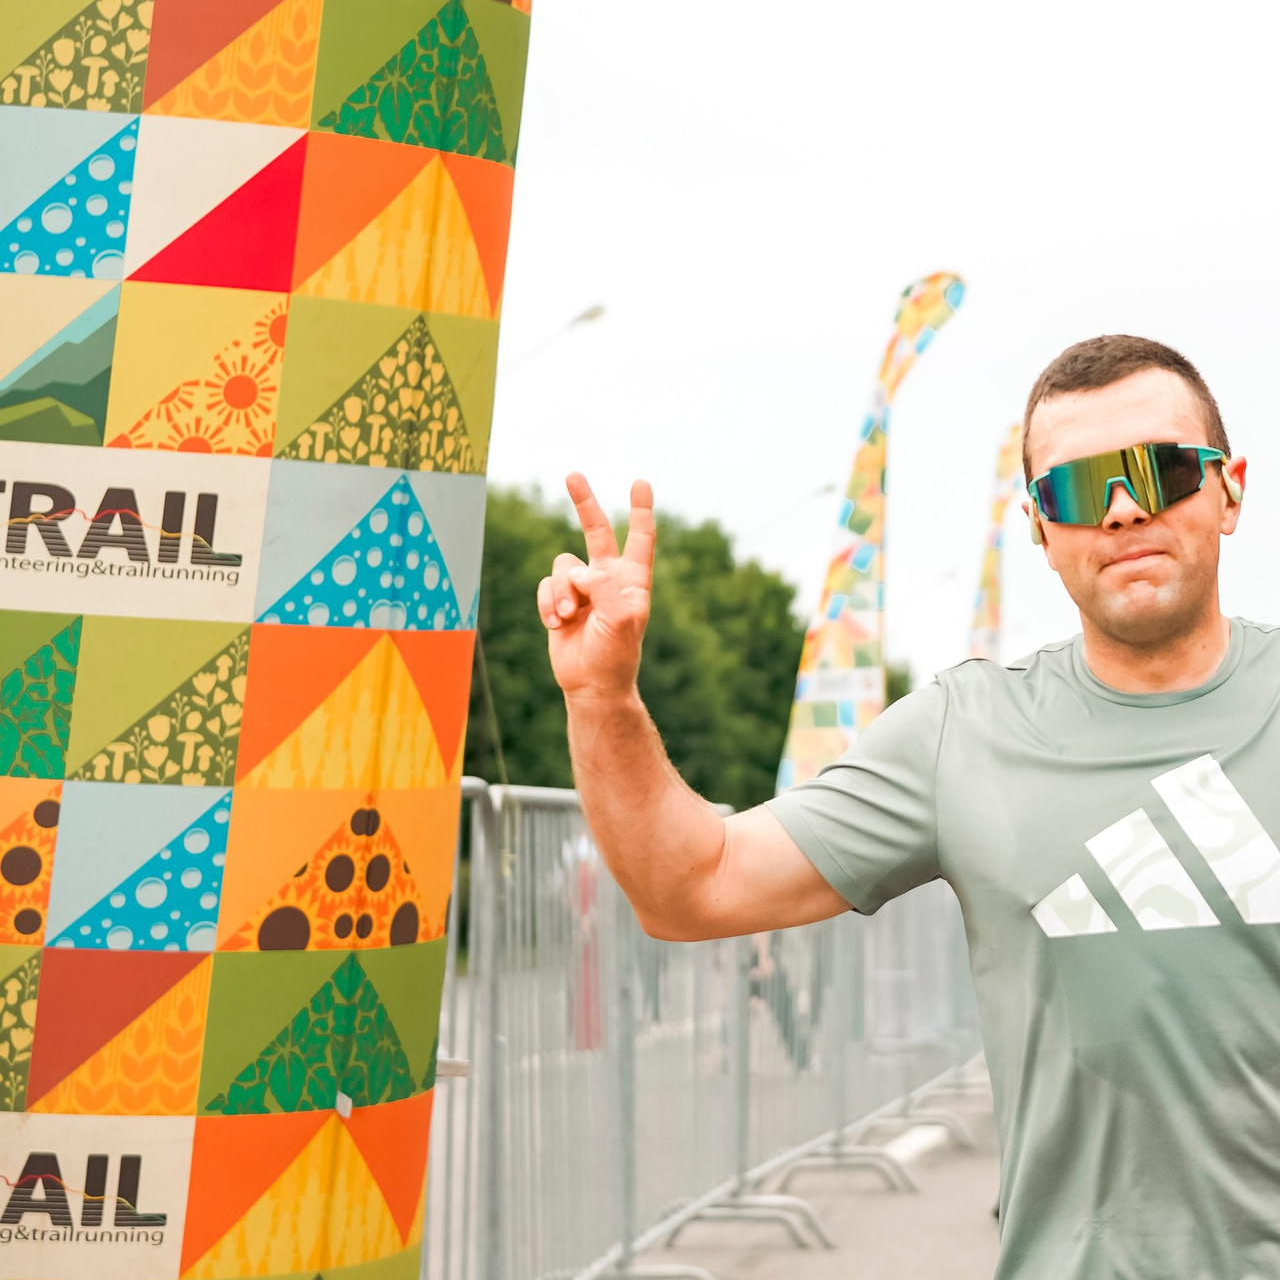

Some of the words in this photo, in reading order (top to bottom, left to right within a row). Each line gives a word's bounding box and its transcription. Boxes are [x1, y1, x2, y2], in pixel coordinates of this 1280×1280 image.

[0, 480, 243, 566] RAIL
[0, 556, 240, 586] nteering&trailrunning
[0, 1224, 165, 1245] g&trailrunning
